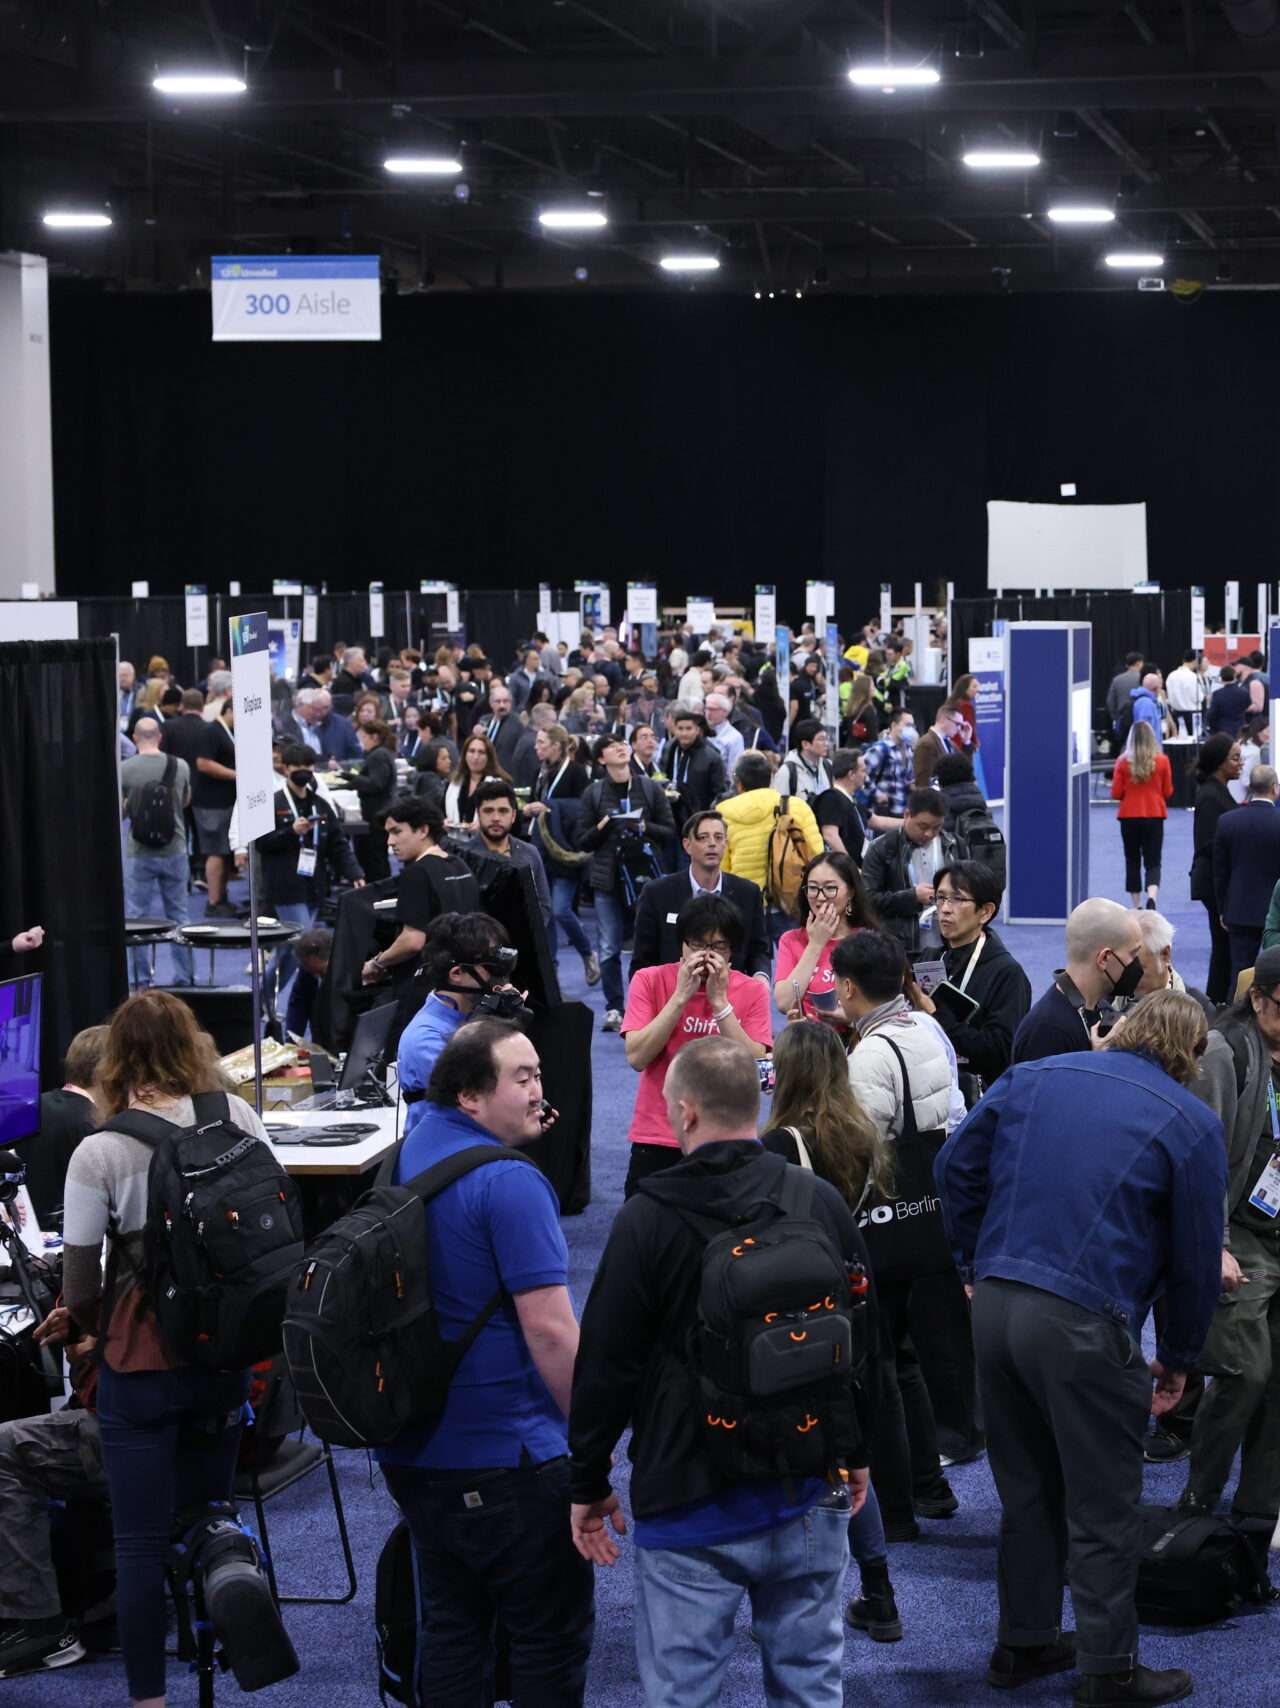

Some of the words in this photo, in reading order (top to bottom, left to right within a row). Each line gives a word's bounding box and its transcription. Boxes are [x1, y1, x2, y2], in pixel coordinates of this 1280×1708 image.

[245, 293, 291, 315] 300
[296, 291, 352, 315] Aisle
[896, 1195, 944, 1220] Berlin
